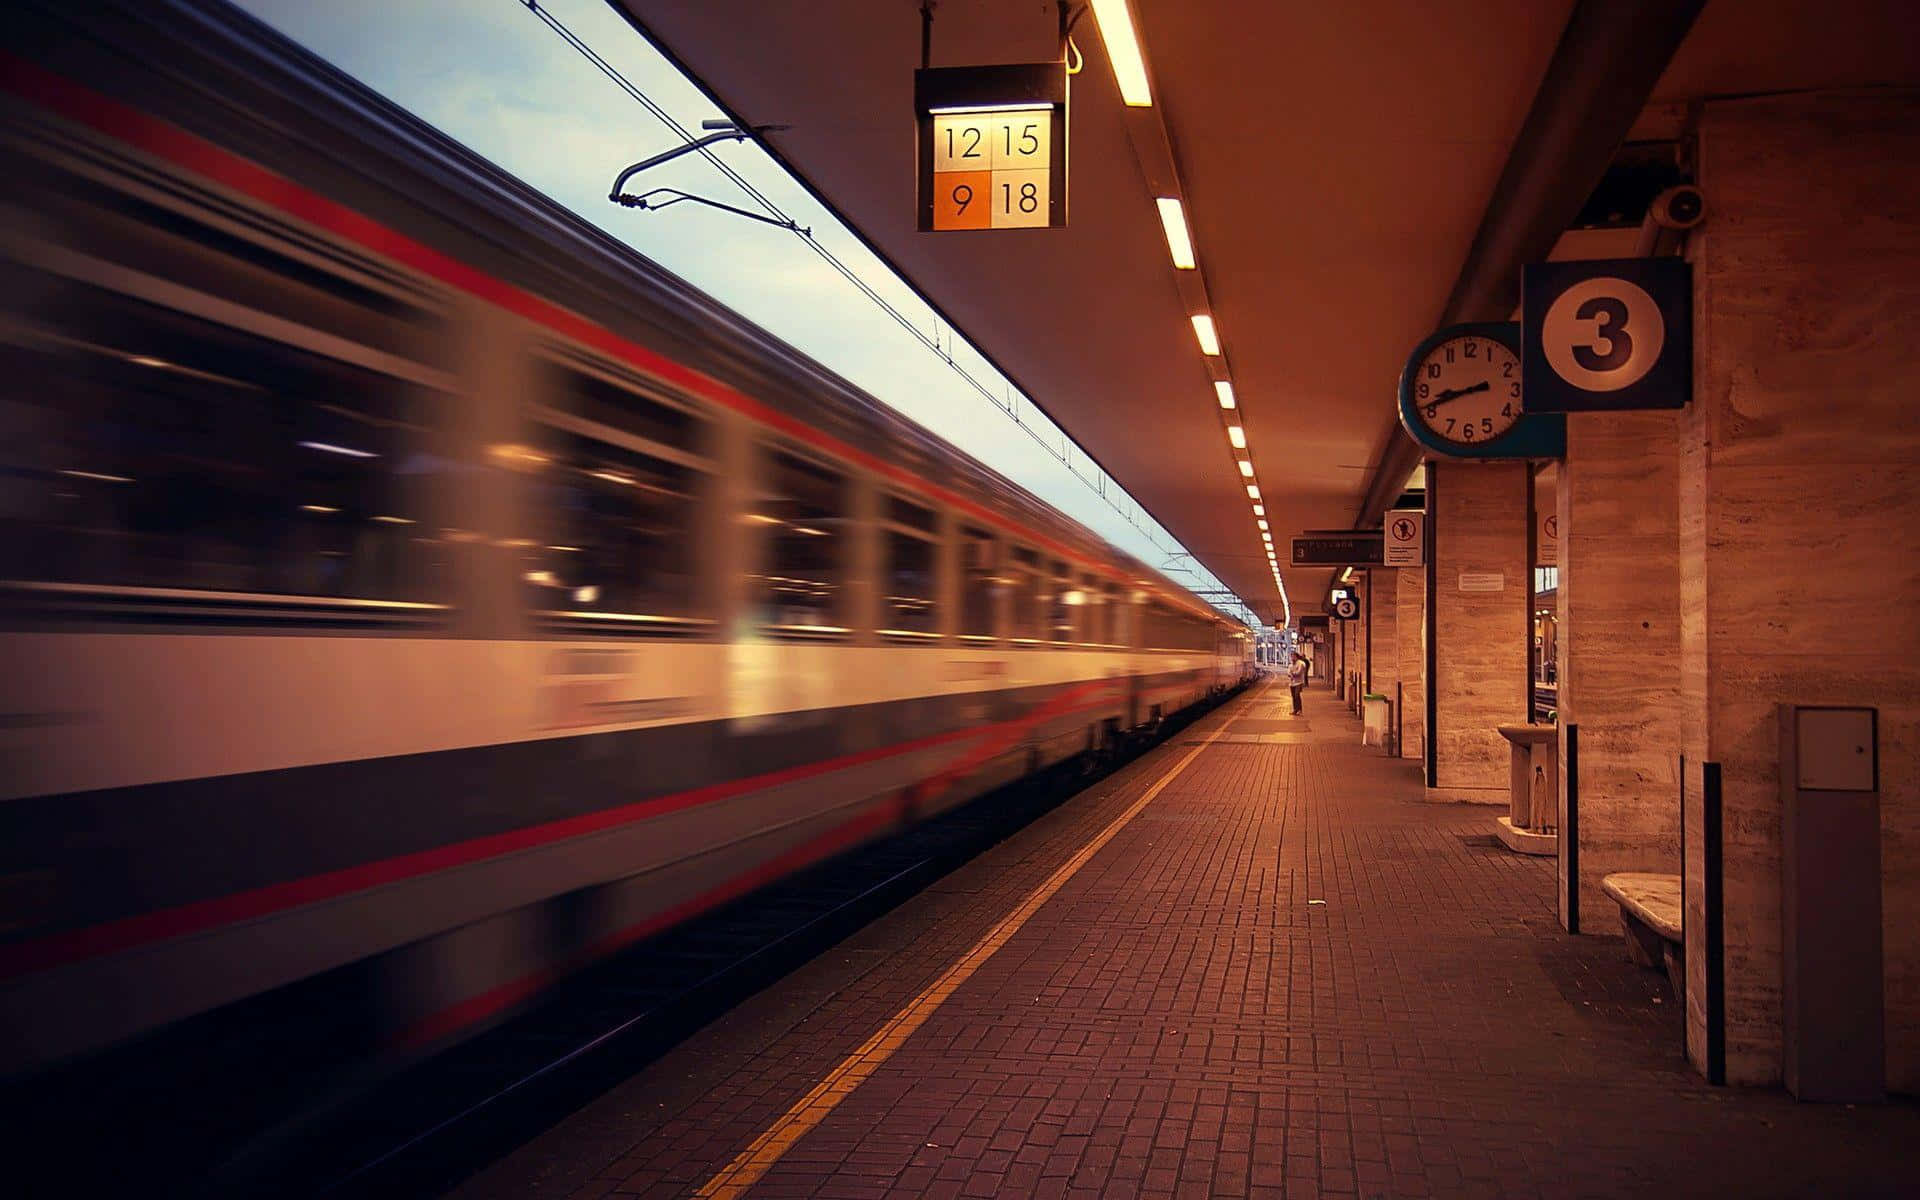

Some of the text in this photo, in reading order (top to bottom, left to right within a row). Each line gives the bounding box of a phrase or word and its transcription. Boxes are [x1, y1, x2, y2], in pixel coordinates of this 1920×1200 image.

[946, 127, 981, 158] 12
[1003, 125, 1038, 156] 15
[952, 185, 972, 216] 9
[1002, 183, 1038, 214] 18
[1571, 297, 1633, 371] 3
[1446, 348, 1455, 362] 11
[1464, 343, 1477, 358] 12
[1487, 347, 1492, 362] 1
[1428, 363, 1441, 378] 10
[1503, 362, 1513, 378] 2
[1419, 384, 1429, 398] 9
[1510, 382, 1521, 398] 3
[1427, 403, 1437, 418] 8
[1502, 402, 1512, 418] 4
[1446, 418, 1456, 434] 7
[1463, 423, 1474, 439] 6
[1481, 418, 1492, 433] 5
[1296, 548, 1304, 558] 3
[1341, 602, 1351, 614] 3
